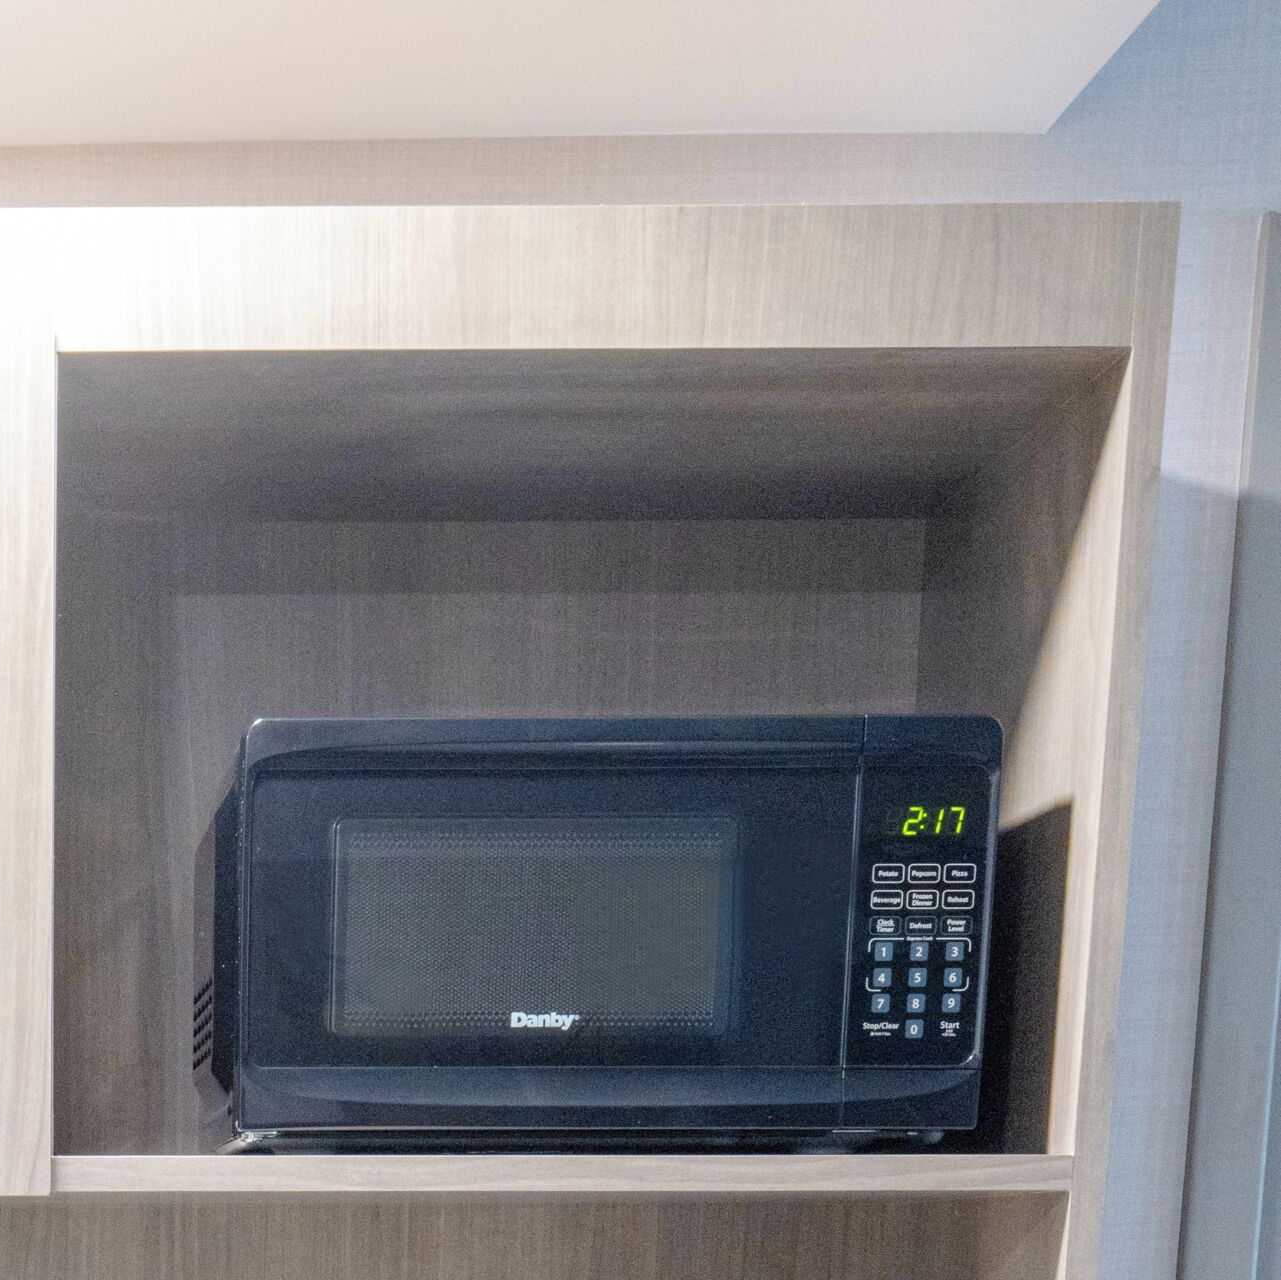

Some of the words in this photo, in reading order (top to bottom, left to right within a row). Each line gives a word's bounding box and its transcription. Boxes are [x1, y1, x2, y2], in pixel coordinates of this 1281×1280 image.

[902, 806, 966, 836] 2:17
[911, 870, 937, 879] Popcorn
[873, 896, 901, 904] Beverage
[880, 947, 886, 957] 1
[915, 947, 923, 957] 2
[951, 947, 958, 957] 3
[878, 973, 885, 983] 4
[914, 973, 921, 983] 5
[949, 973, 956, 983] 6
[877, 999, 884, 1009] 7
[912, 999, 919, 1009] 8
[948, 999, 955, 1009] 9
[511, 1012, 575, 1030] Danby
[862, 1022, 900, 1030] Stop/Clear
[940, 1021, 960, 1029] Start
[910, 1024, 918, 1035] 0
